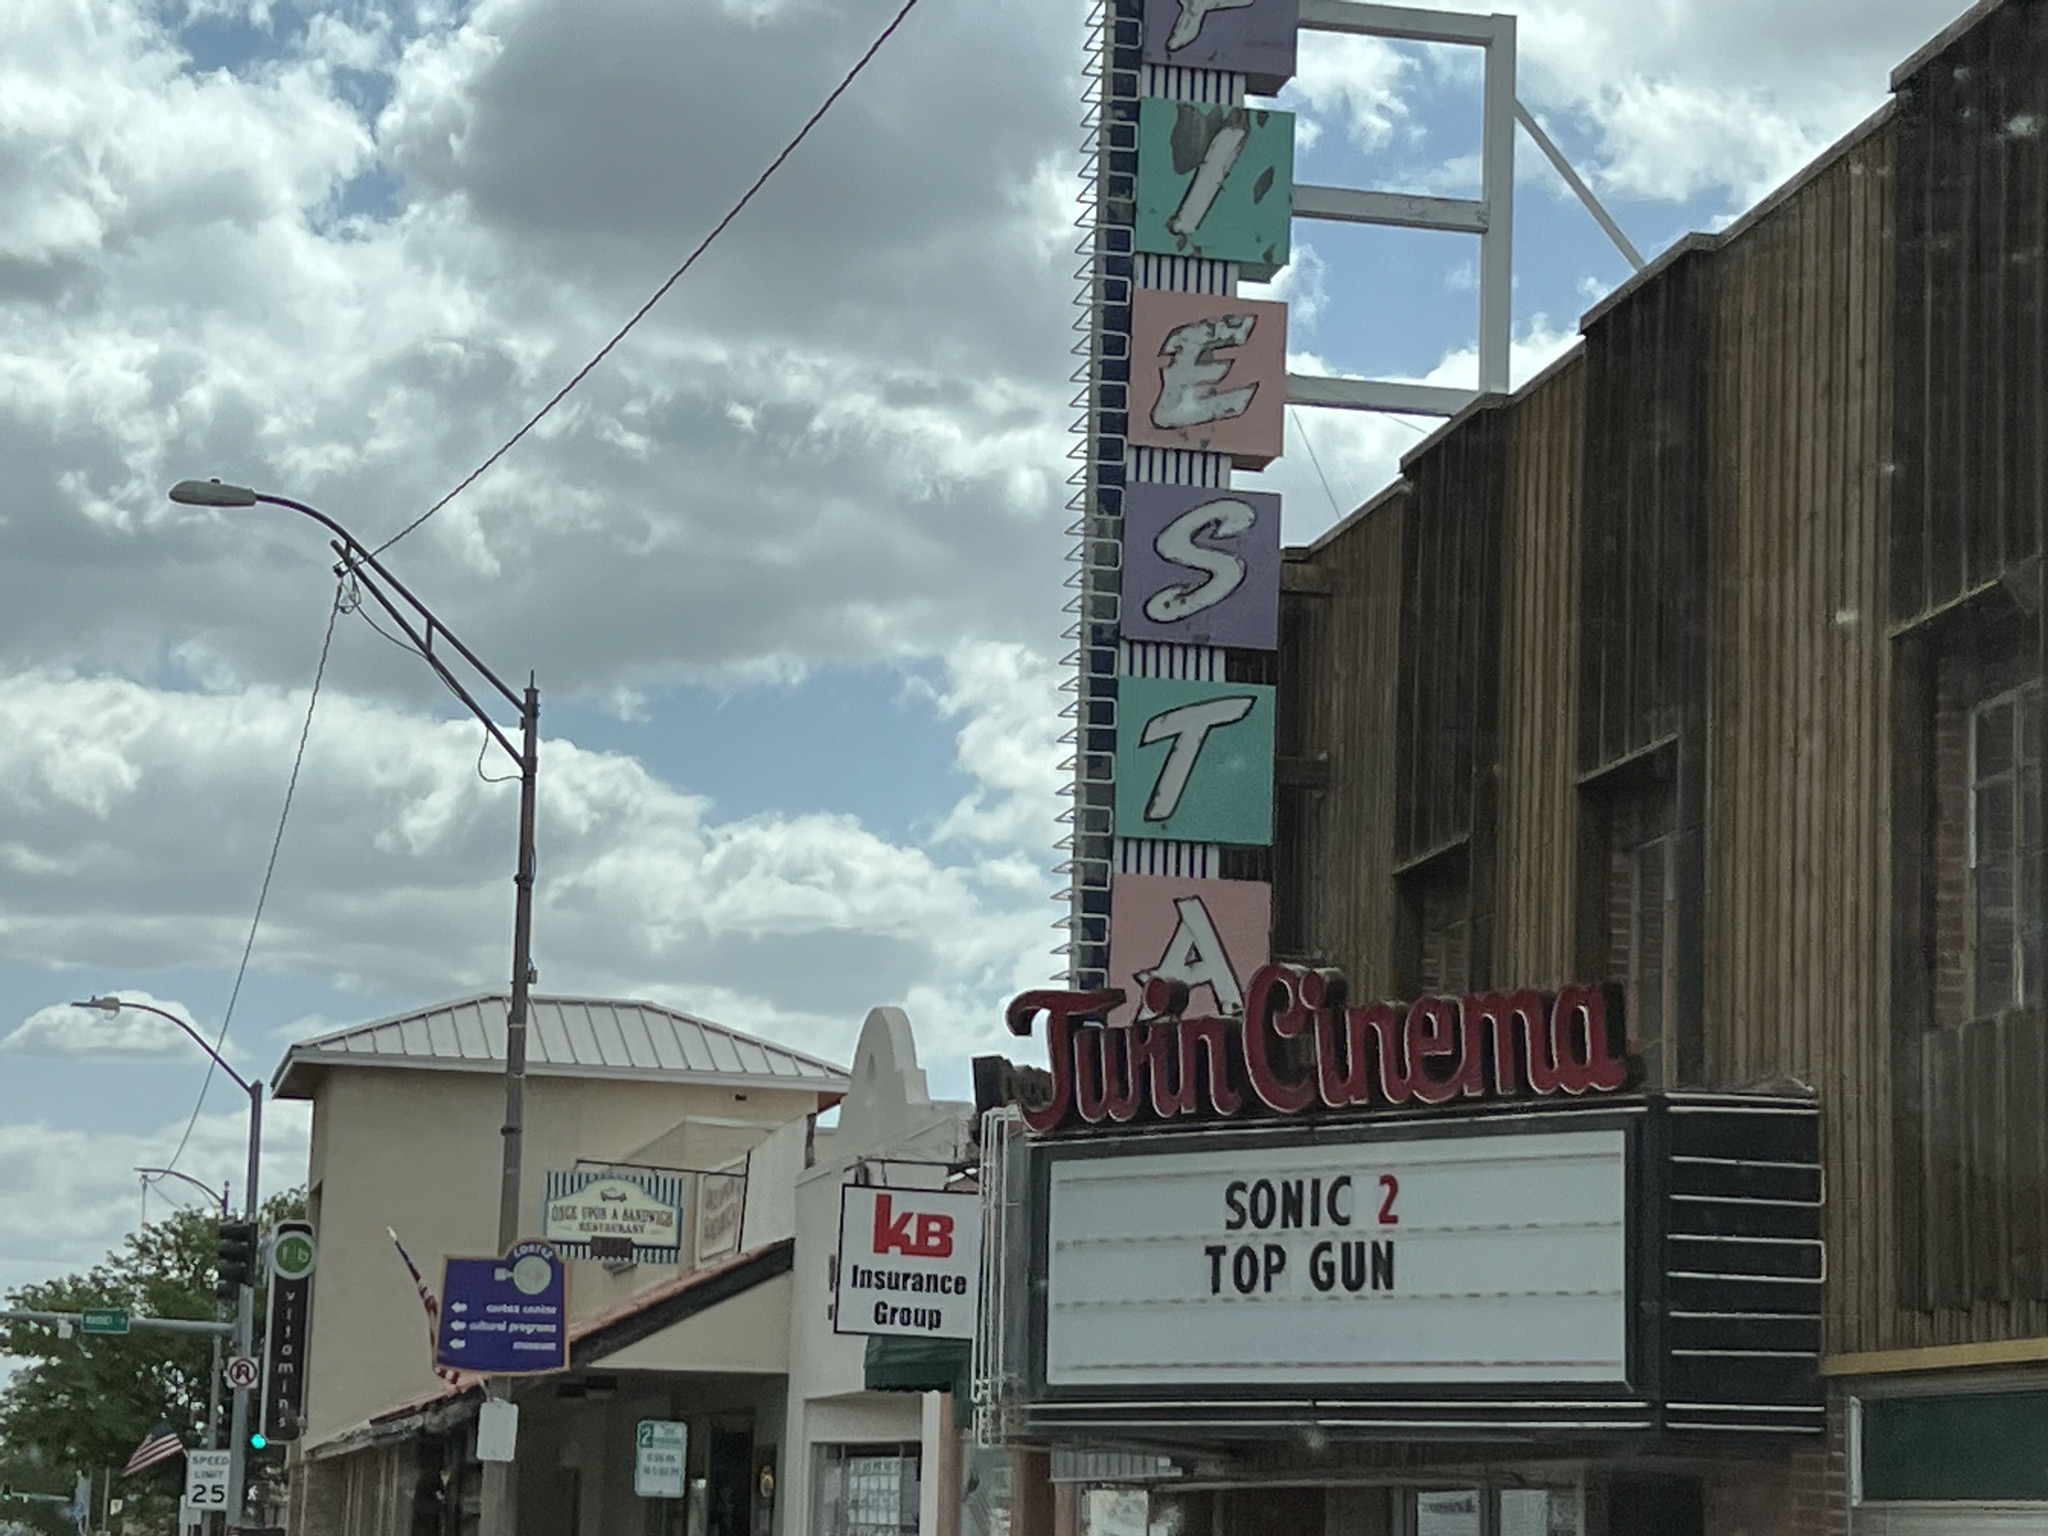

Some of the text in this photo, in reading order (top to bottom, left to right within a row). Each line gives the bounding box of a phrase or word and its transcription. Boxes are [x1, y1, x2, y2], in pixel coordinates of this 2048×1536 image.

[1005, 962, 1628, 1133] Twin Cinema
[1224, 1173, 1400, 1230] SONIC 2
[850, 1264, 967, 1296] Insurance
[1204, 1240, 1395, 1295] TOP GUN
[873, 1300, 942, 1331] Group
[192, 1455, 229, 1466] SPEED
[192, 1483, 225, 1503] 25
